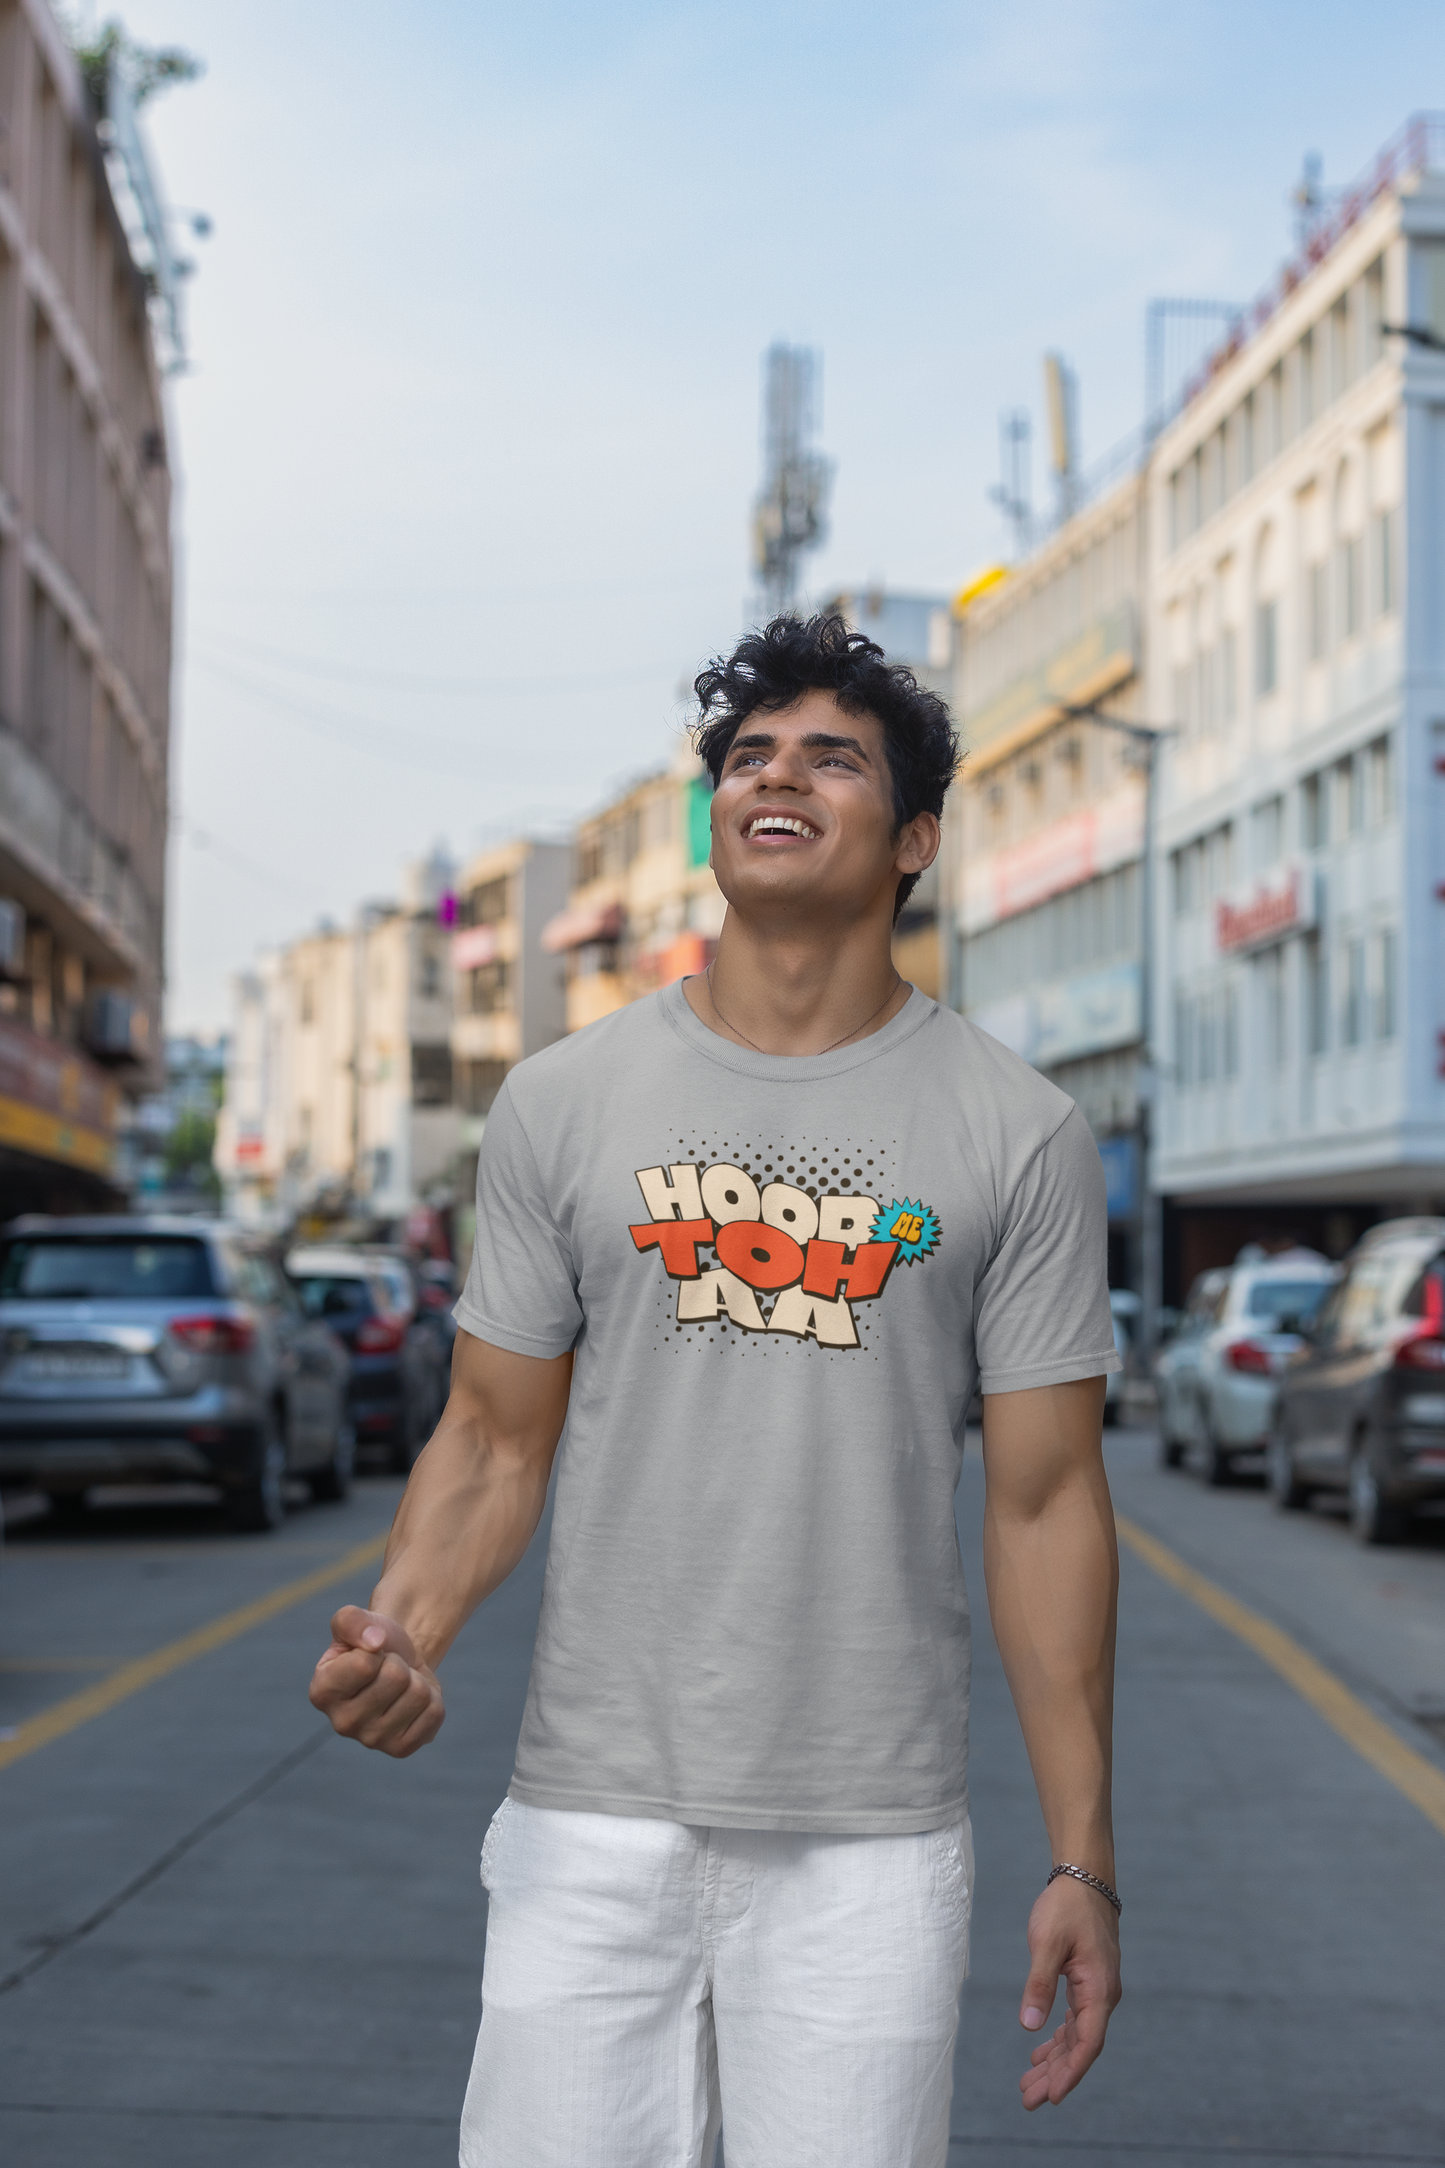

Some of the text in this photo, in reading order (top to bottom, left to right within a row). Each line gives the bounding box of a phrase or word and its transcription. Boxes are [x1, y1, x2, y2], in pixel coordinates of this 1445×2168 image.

[628, 1218, 901, 1304] TOH
[889, 1211, 925, 1246] ME
[676, 1267, 861, 1349] AA
